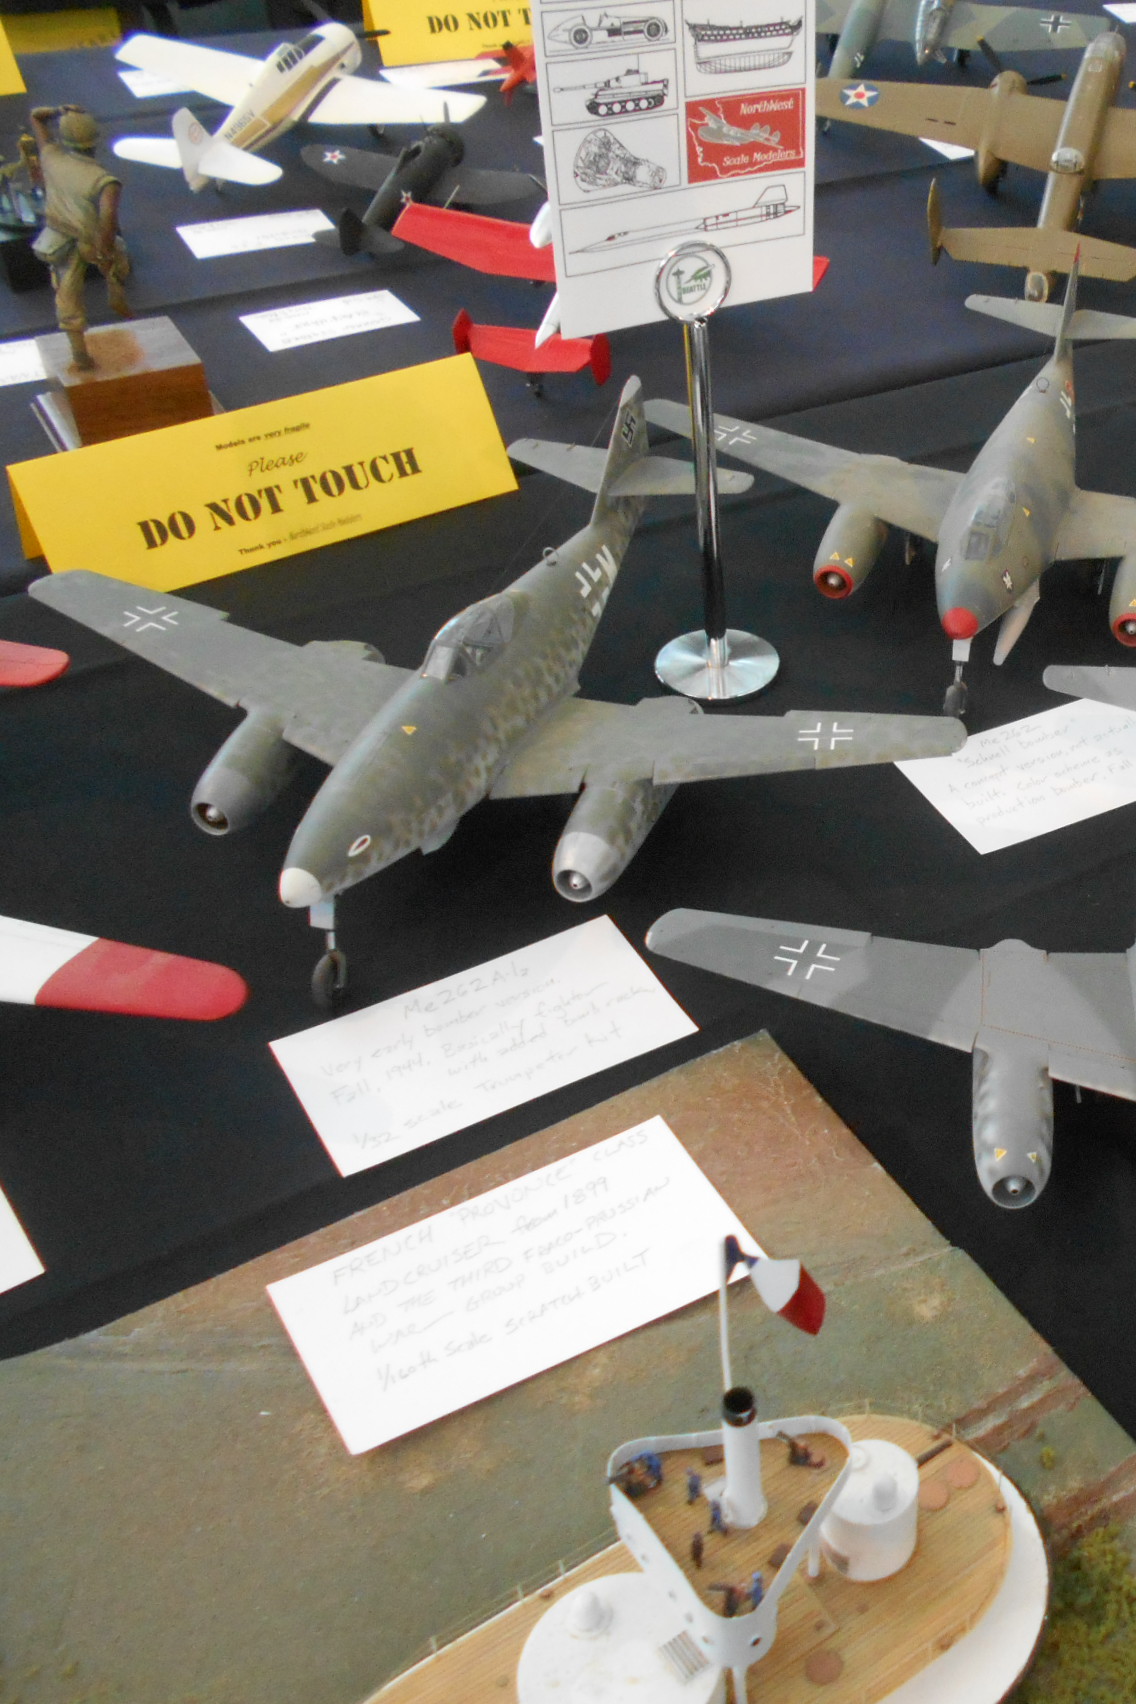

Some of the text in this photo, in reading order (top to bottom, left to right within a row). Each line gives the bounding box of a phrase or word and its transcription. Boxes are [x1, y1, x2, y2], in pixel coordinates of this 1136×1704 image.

[427, 14, 459, 34] DO
[466, 9, 511, 31] NOT
[722, 149, 796, 166] Scale Modelers
[215, 439, 246, 451] Models
[264, 430, 281, 440] very
[247, 452, 307, 477] Please
[137, 447, 423, 550] DO NOT TOUCH
[238, 544, 264, 555] Thank
[267, 540, 282, 549] you
[371, 1033, 415, 1058] early
[423, 1004, 488, 1038] bomber
[441, 1018, 525, 1059] Basically
[534, 981, 610, 1019] fighter
[402, 1099, 463, 1130] scale
[583, 1020, 623, 1048] kit
[447, 1052, 489, 1078] with
[497, 1029, 548, 1057] added
[333, 1226, 434, 1287] FRENCH
[591, 1130, 650, 1163] CLASS
[563, 1175, 610, 1210] 1899
[348, 1312, 389, 1341] AND
[396, 1289, 438, 1312] THE
[447, 1256, 513, 1292] THIRD
[465, 1273, 526, 1313] GROUP
[503, 1285, 586, 1336] SCRATCH
[587, 1248, 650, 1294] BUILT
